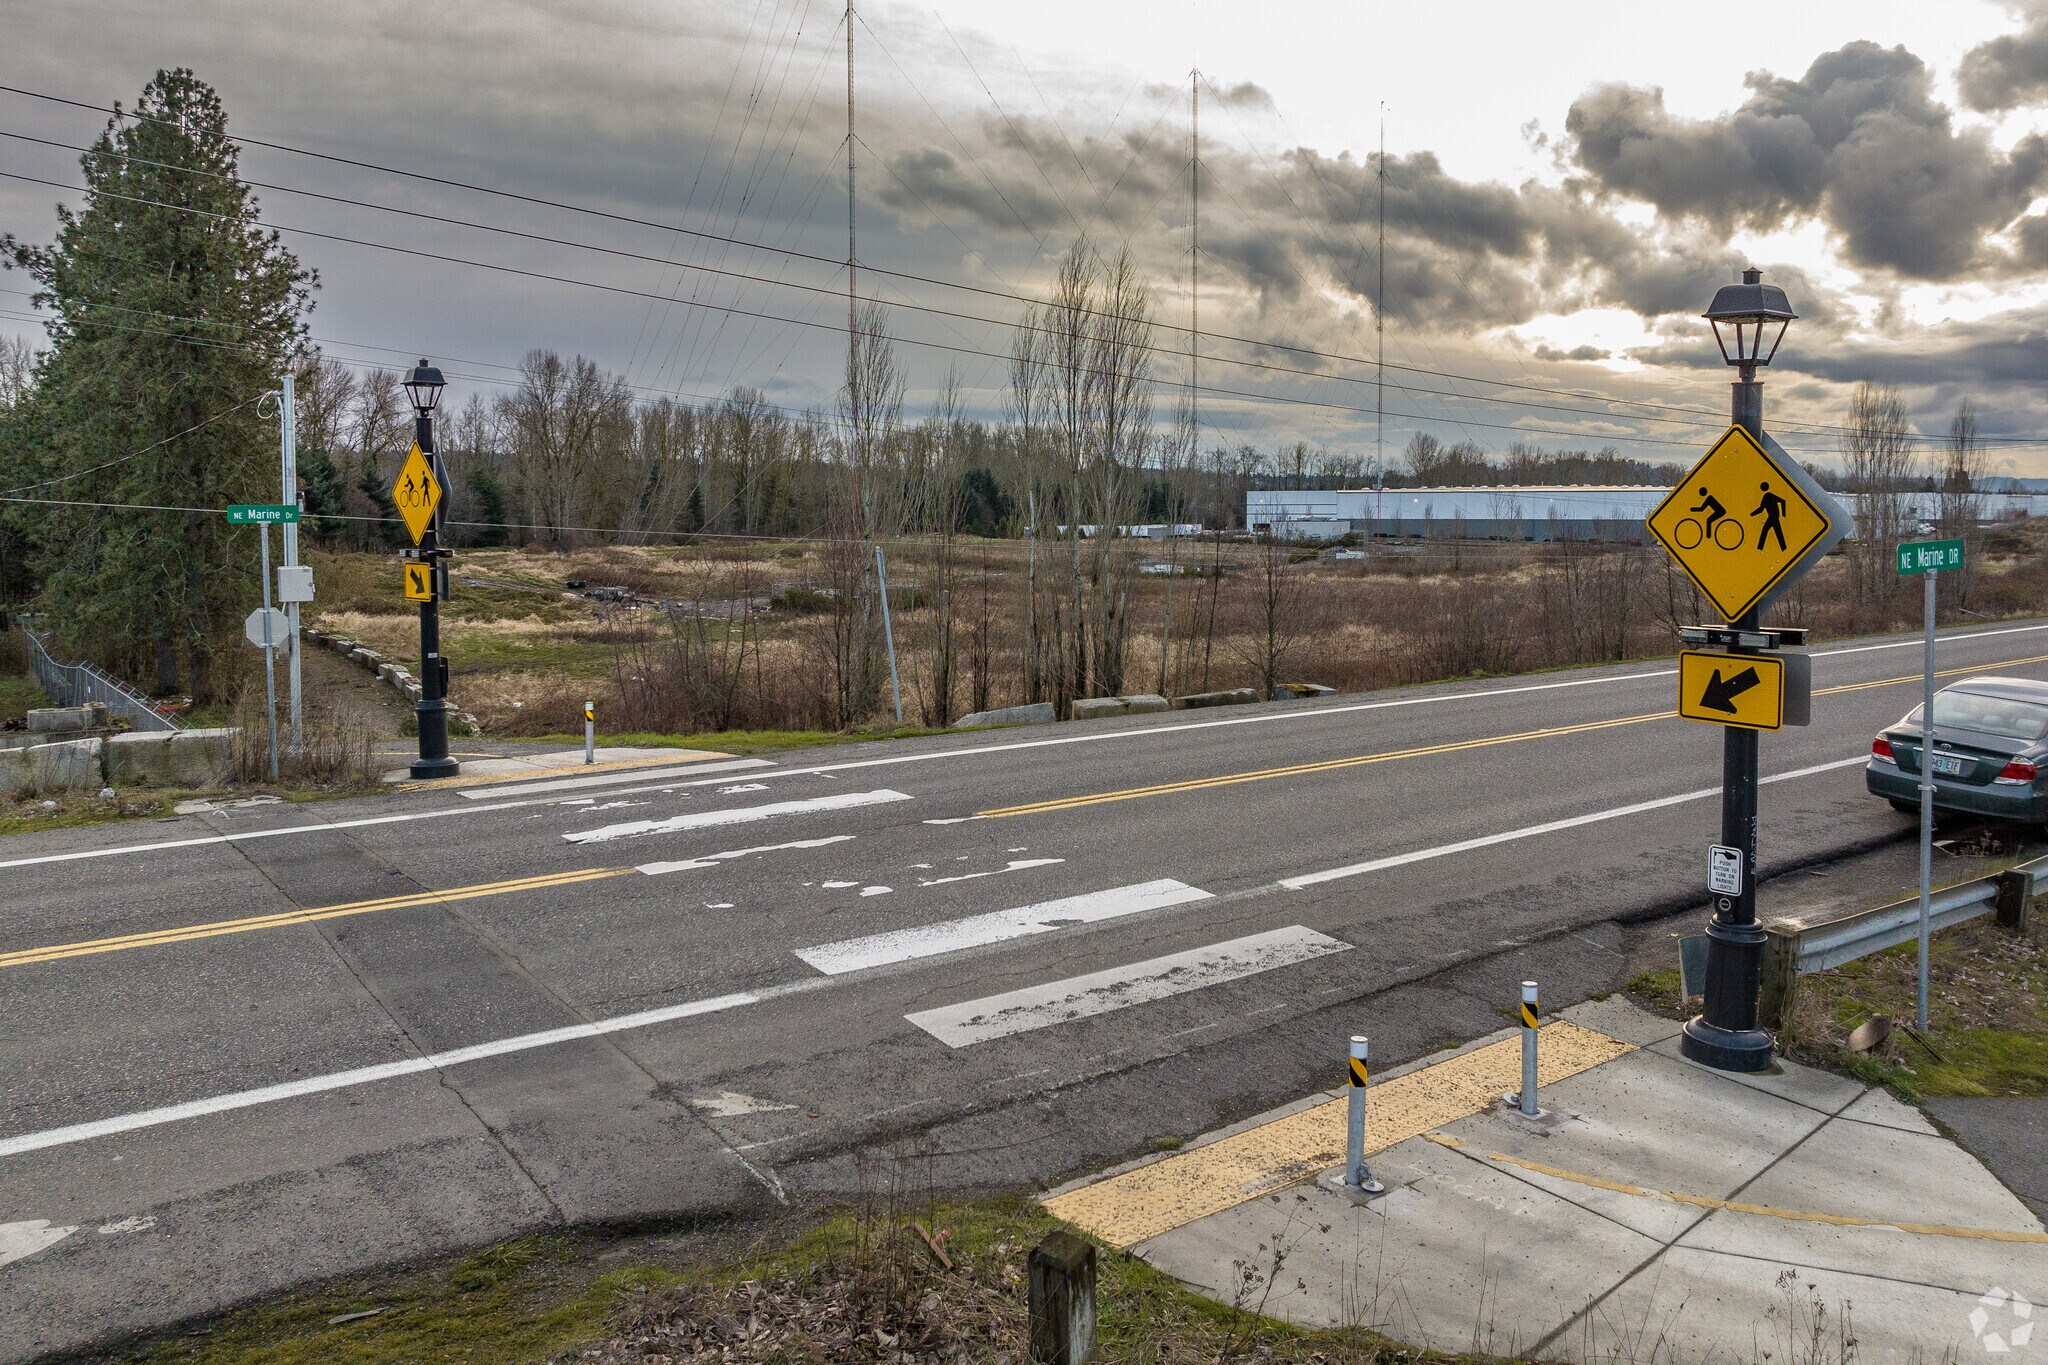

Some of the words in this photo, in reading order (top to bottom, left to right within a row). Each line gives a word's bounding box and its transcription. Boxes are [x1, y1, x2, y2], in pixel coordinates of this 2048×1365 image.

[248, 509, 280, 519] Marine
[1902, 552, 1912, 569] NE
[1918, 547, 1944, 567] Marine
[1949, 548, 1959, 564] DR
